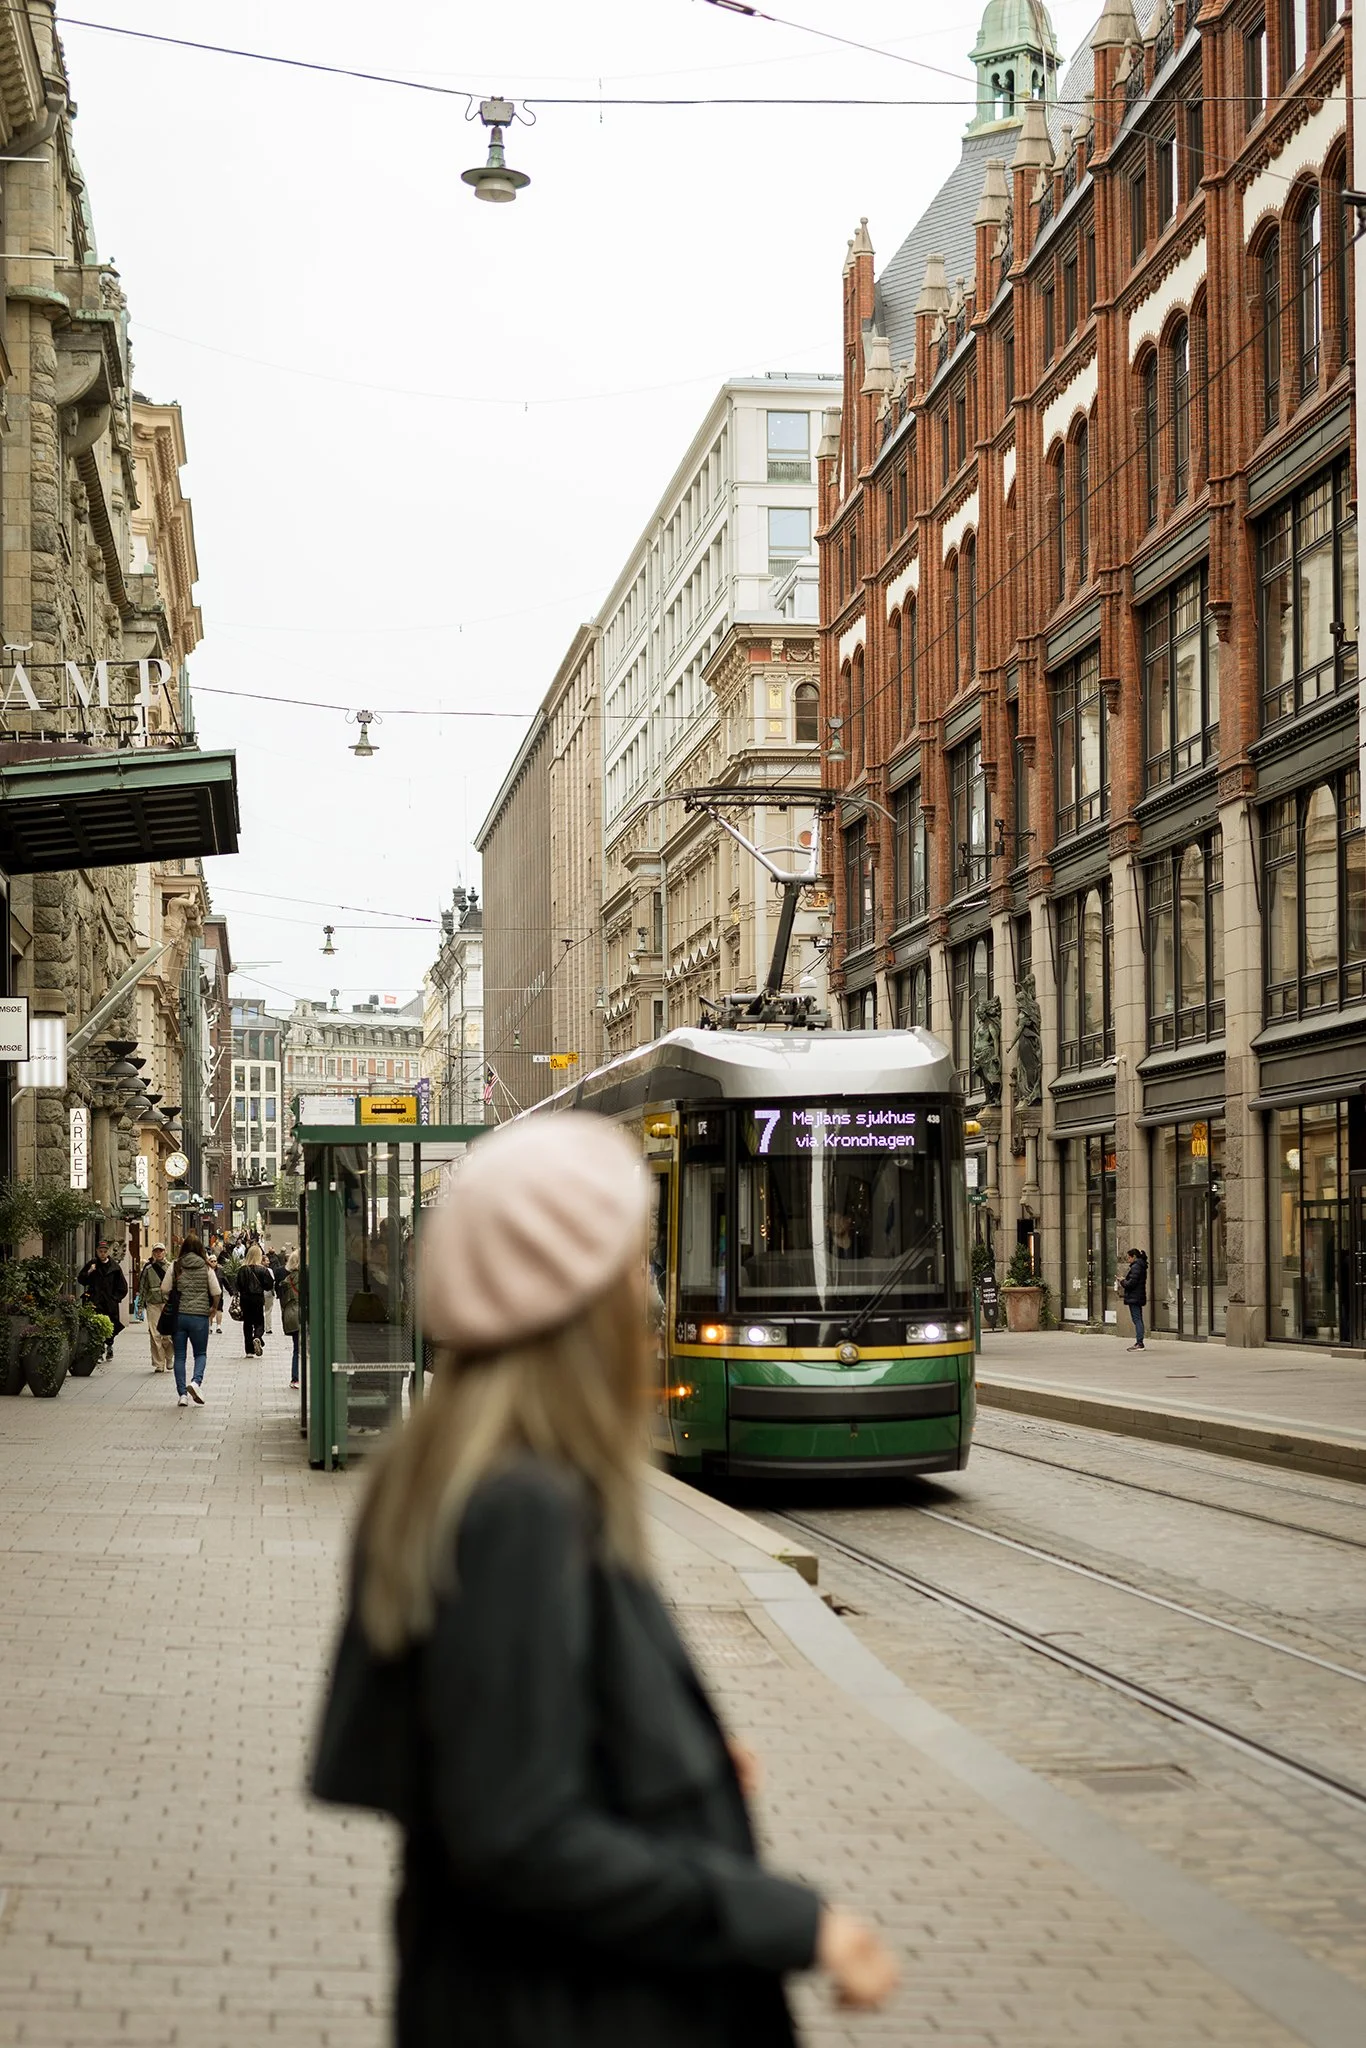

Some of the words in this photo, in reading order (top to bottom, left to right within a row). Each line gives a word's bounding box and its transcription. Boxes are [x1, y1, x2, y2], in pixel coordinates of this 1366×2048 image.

[754, 1110, 780, 1153] 7
[792, 1111, 851, 1128] Mejlans
[855, 1110, 916, 1128] sjukhus
[73, 1110, 84, 1187] ARKET
[796, 1133, 820, 1148] via
[824, 1132, 915, 1150] Kronohagen
